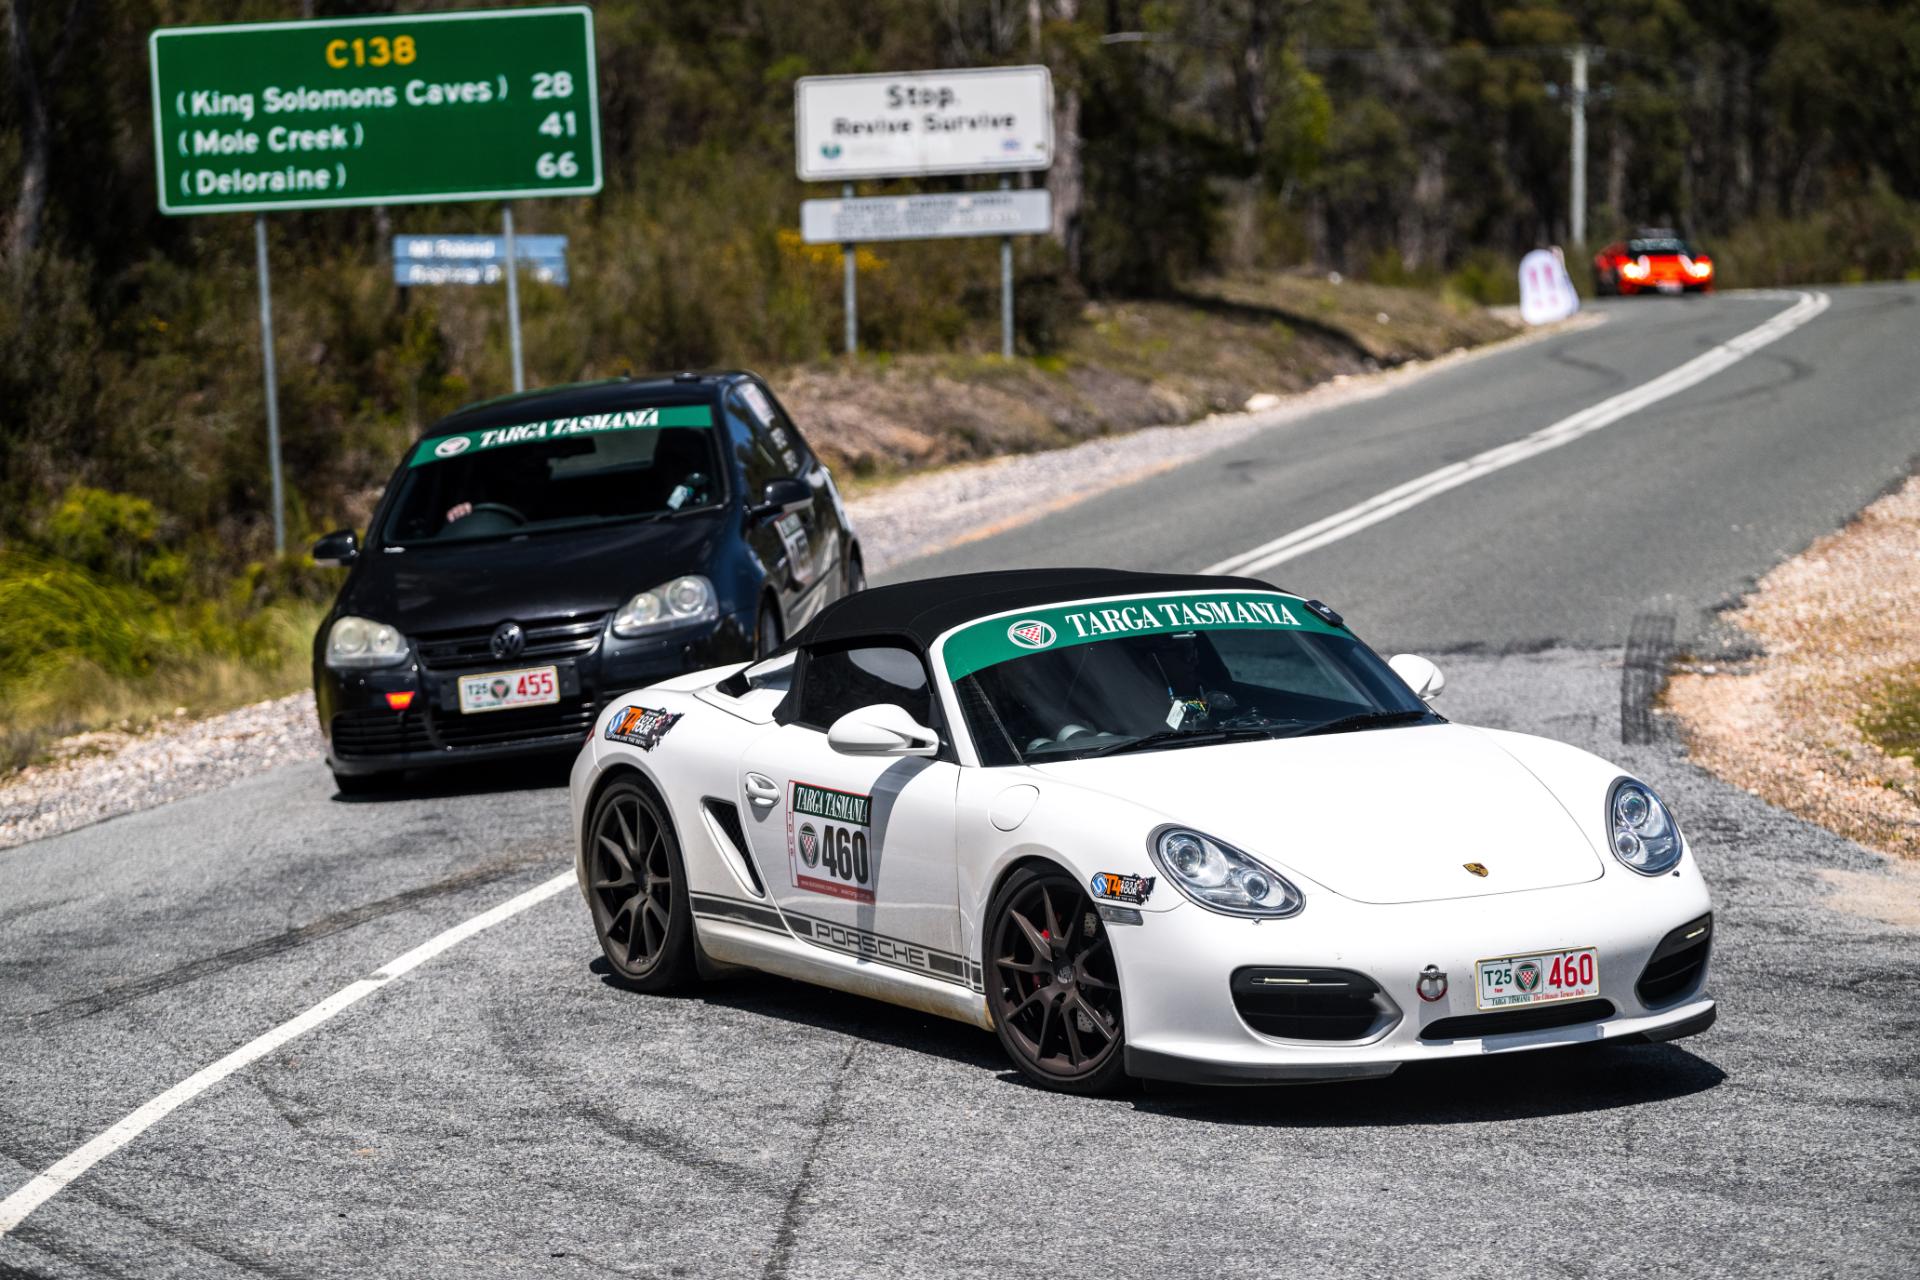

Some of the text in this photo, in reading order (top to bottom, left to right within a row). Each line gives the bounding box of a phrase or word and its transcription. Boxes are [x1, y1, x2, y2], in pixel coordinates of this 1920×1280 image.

[326, 35, 417, 69] C138
[262, 86, 397, 114] Solomons
[531, 71, 573, 100] 28
[887, 84, 955, 110] Stop
[538, 111, 577, 138] 41
[833, 113, 1015, 136] Revive Survive
[536, 152, 579, 179] 66
[479, 408, 659, 449] TARGA TASMANIA
[1064, 601, 1302, 639] TARGA TASMANIA
[468, 673, 553, 696] T25 455
[796, 787, 868, 823] TARGA TASMANIA
[822, 824, 869, 884] 460
[816, 923, 925, 967] PORSCHE
[1484, 953, 1593, 989] T25 460
